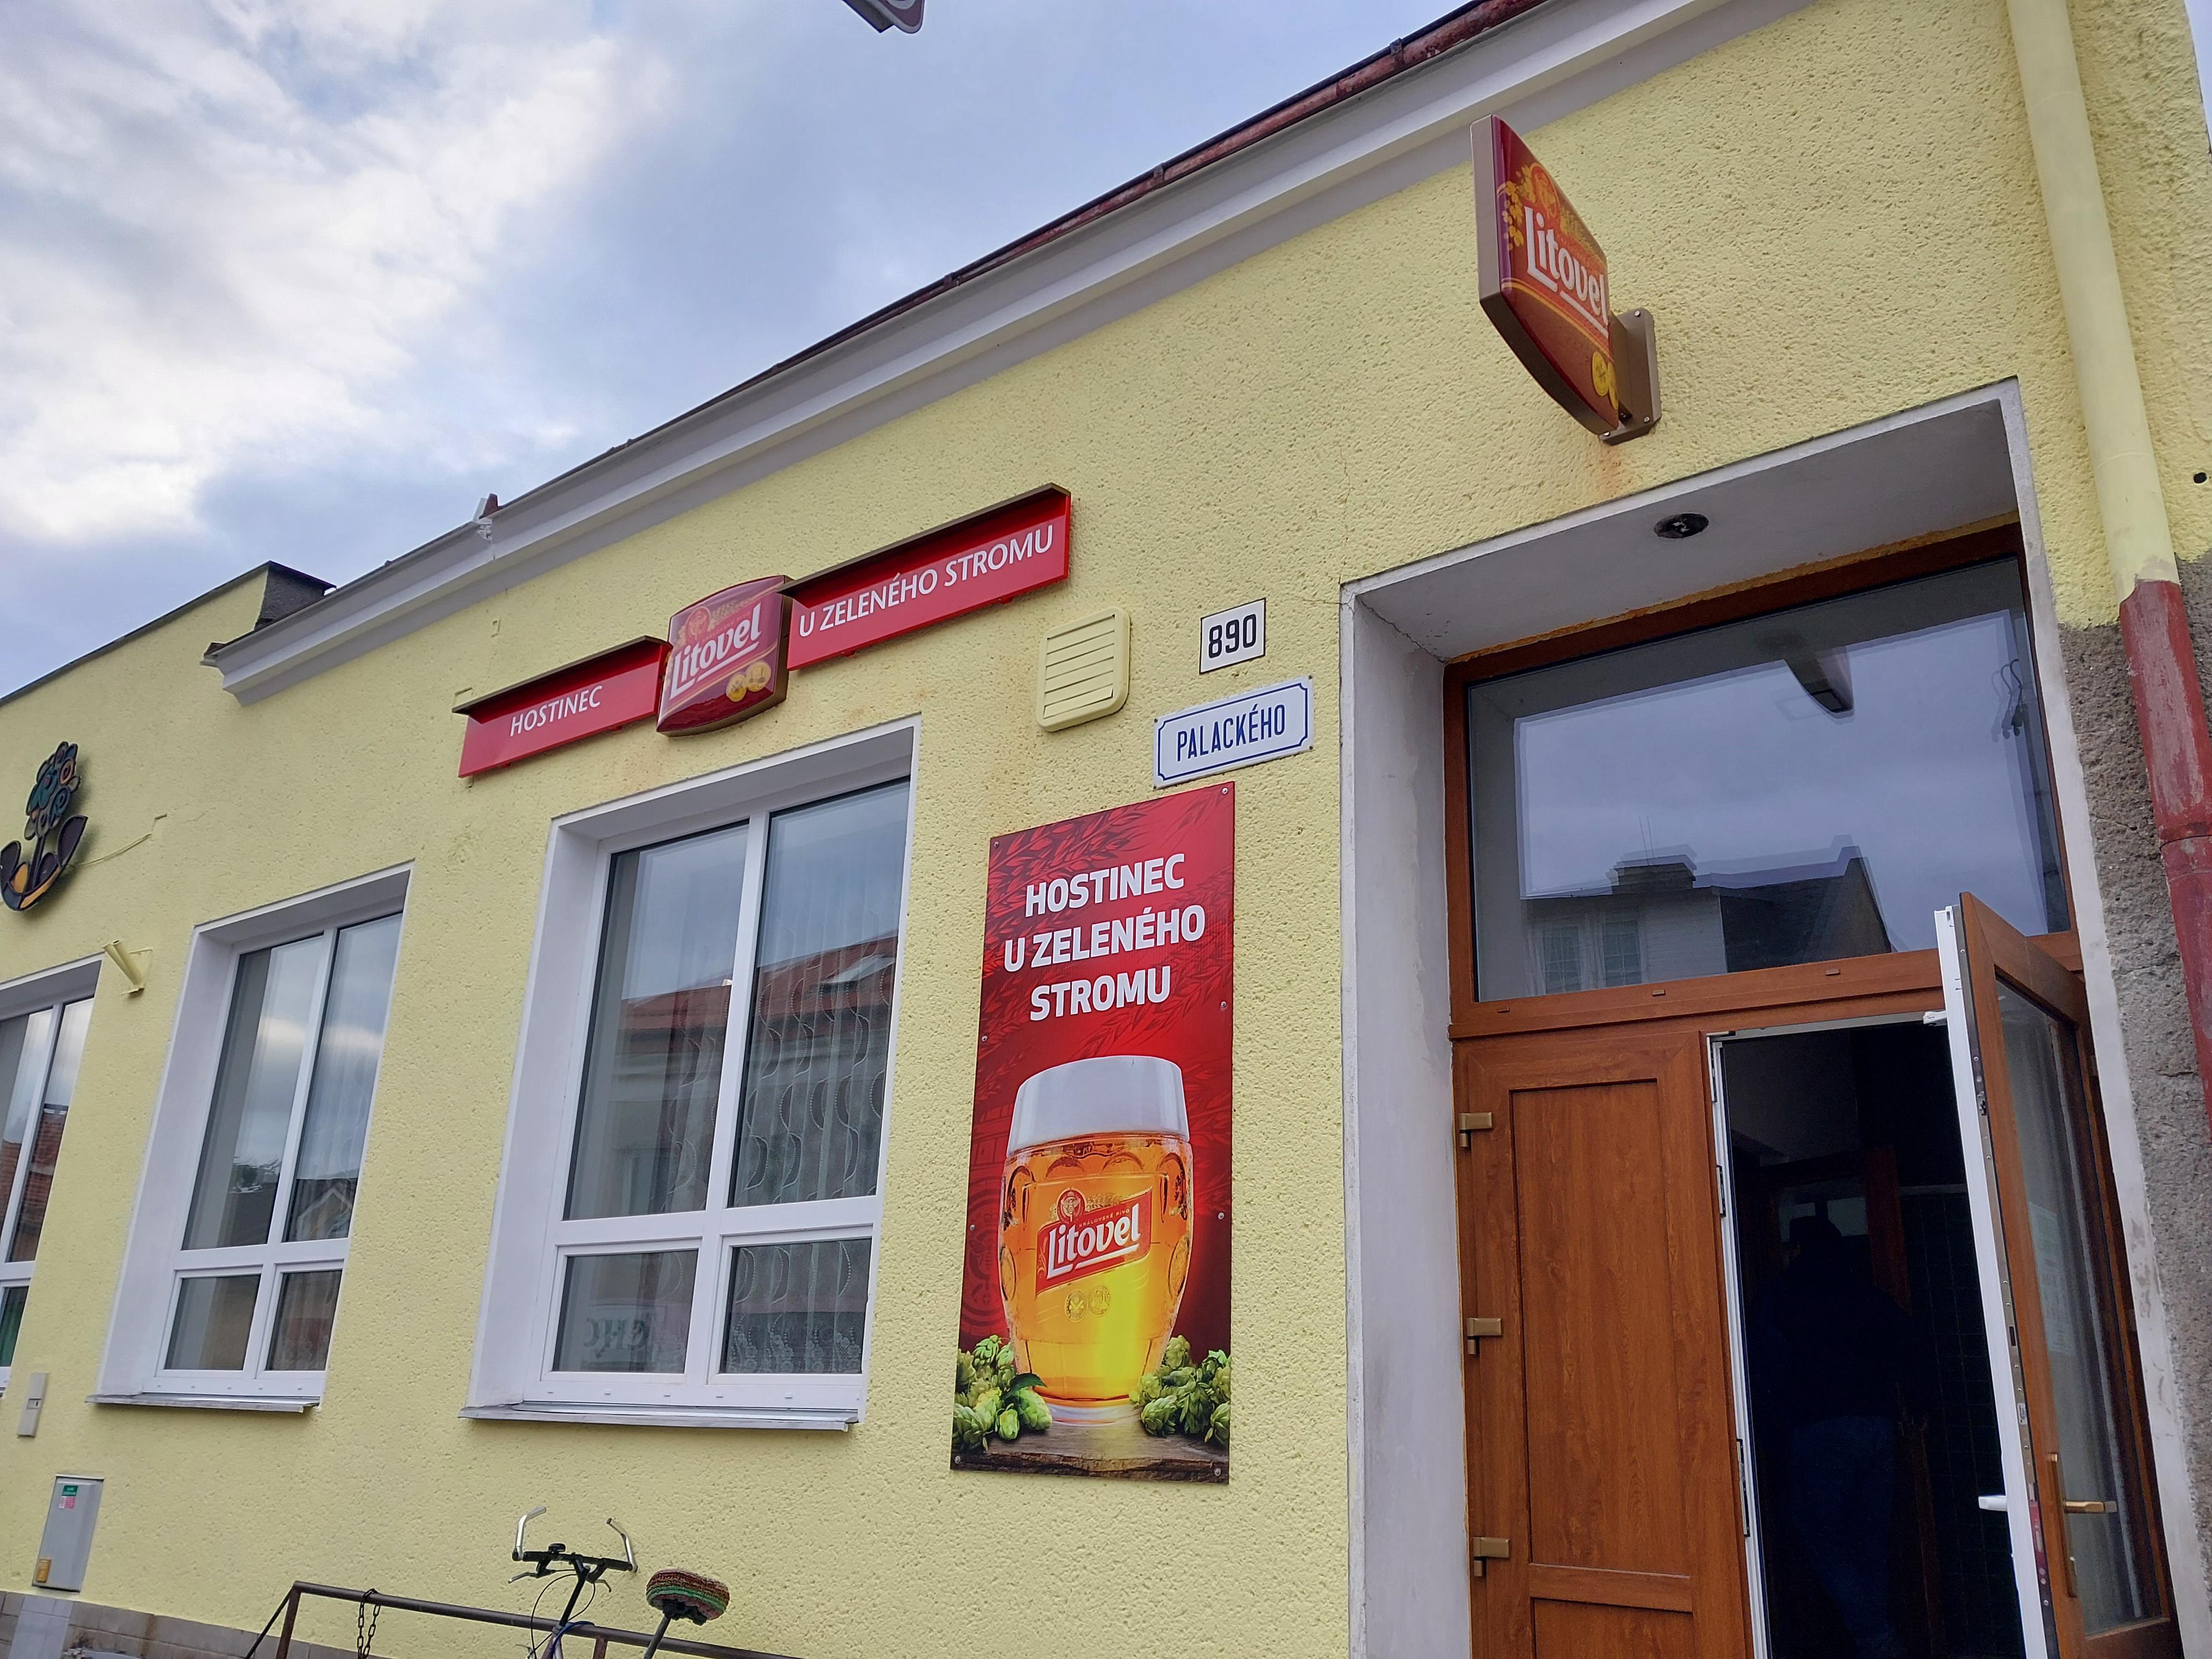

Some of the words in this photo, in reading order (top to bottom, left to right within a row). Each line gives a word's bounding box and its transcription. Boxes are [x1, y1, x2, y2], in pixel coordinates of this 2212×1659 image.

[1524, 206, 1609, 326] Litovel
[799, 614, 815, 637] U
[820, 572, 938, 631] ZELENÉHO
[944, 524, 1053, 587] STROMU
[670, 602, 761, 700] Litovel
[1208, 613, 1256, 659] 890
[510, 685, 602, 737] HOSTINEC
[1177, 703, 1285, 762] PALACKÉHO
[1025, 853, 1185, 917] HOSTINEC
[1004, 937, 1025, 972] U
[1030, 904, 1206, 968] ZELENÉHO
[1030, 965, 1171, 1021] STROMU
[1046, 1203, 1141, 1280] Litovel
[1115, 1208, 1130, 1217] PIVO
